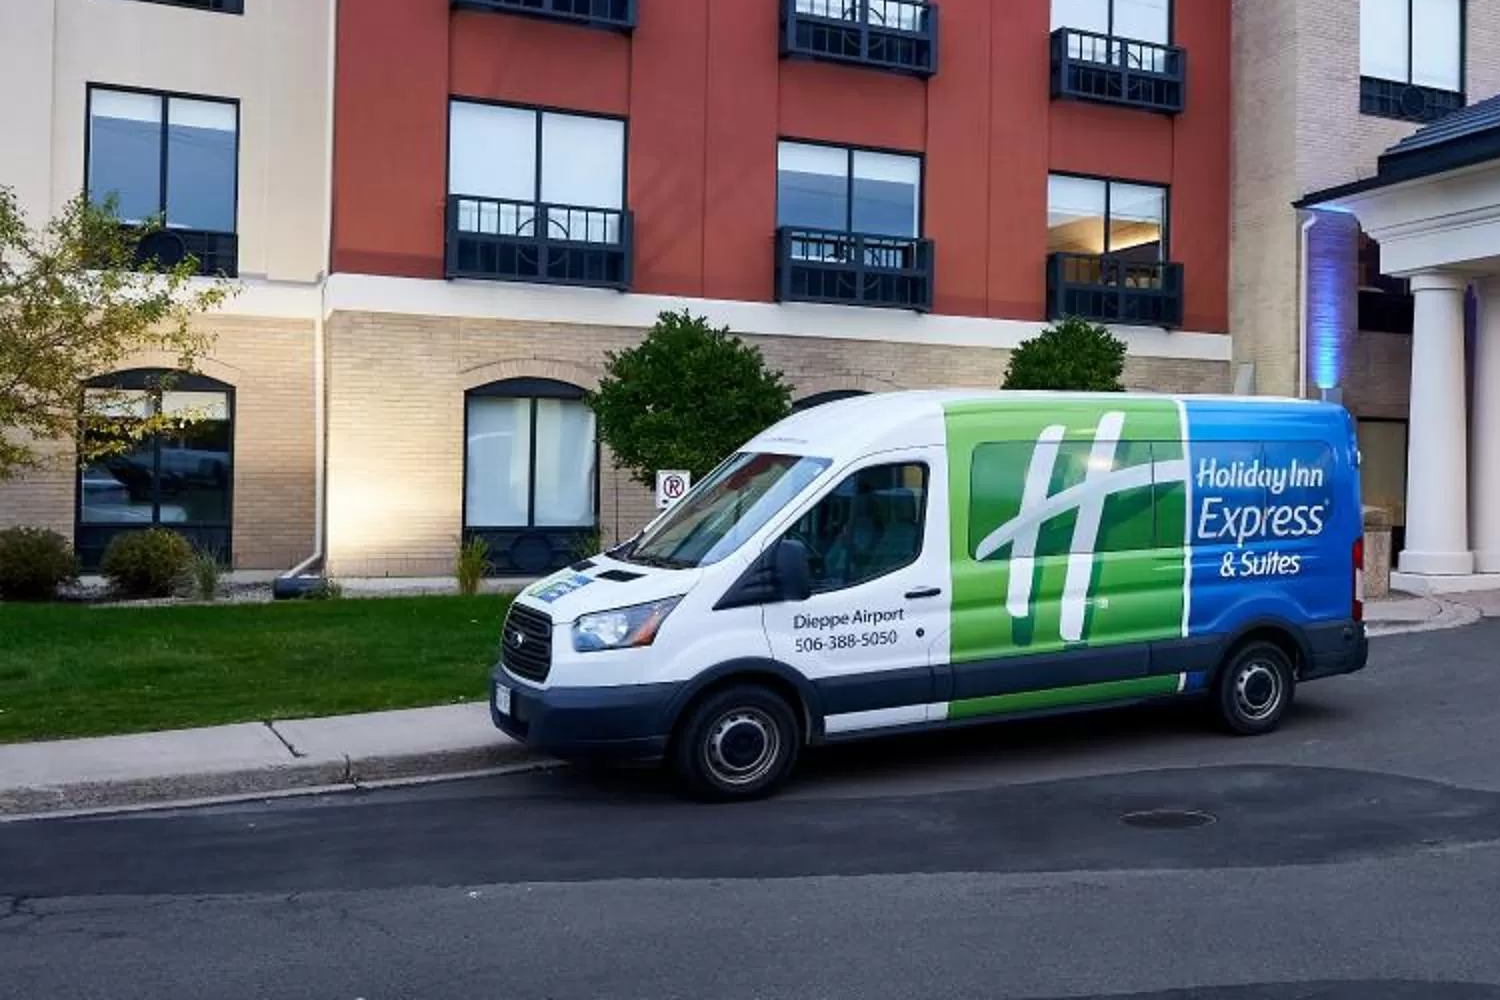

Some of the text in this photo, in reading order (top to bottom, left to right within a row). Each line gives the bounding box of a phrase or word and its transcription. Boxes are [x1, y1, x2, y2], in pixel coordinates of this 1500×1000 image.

[1196, 457, 1324, 494] Holiday Inn
[1197, 497, 1325, 548] Express
[1220, 550, 1301, 577] & Suites
[793, 608, 904, 630] Dieppe Airport
[795, 629, 897, 653] 506-388-5050
